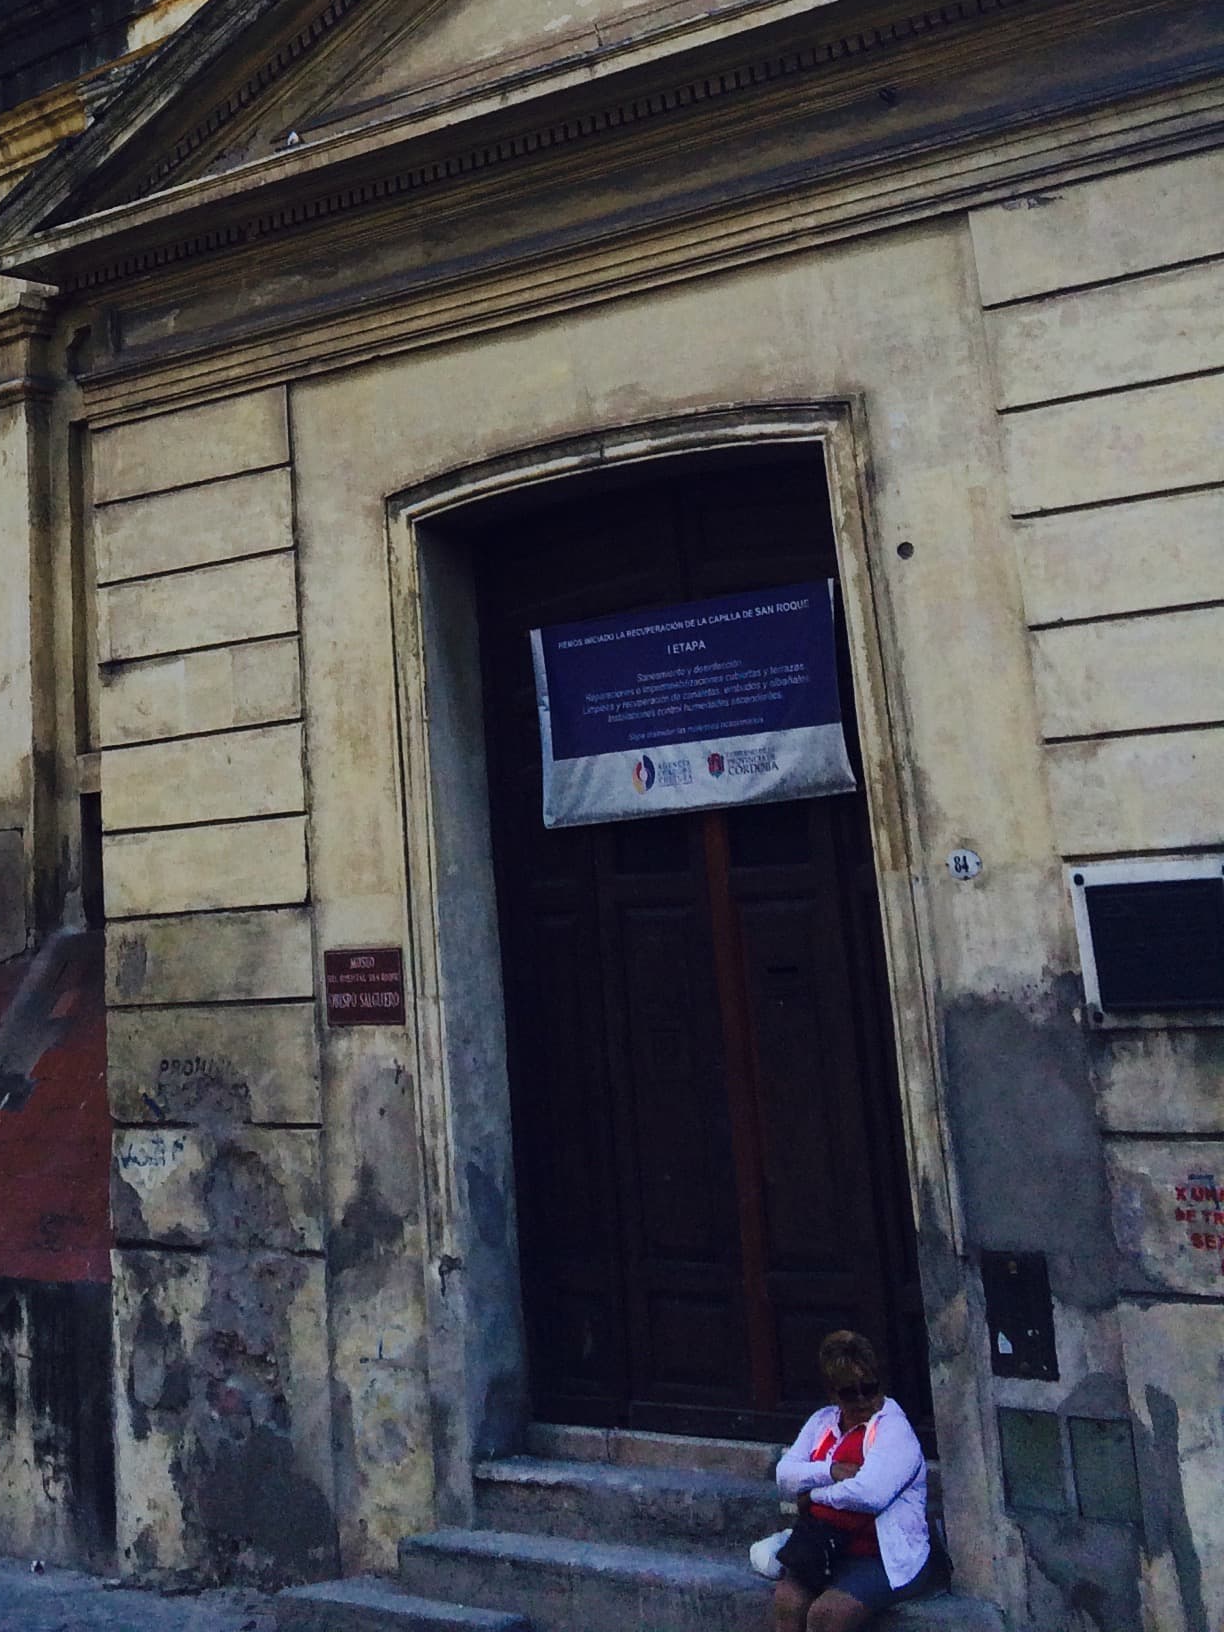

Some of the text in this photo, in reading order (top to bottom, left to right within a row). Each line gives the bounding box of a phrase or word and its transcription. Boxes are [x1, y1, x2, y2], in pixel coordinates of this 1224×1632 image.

[615, 631, 626, 640] LA
[684, 619, 695, 628] DE
[697, 617, 707, 626] LA
[708, 611, 741, 624] CAPILLA
[742, 609, 753, 618] DE
[755, 605, 774, 617] SAN
[776, 599, 809, 613] ROQUE
[673, 640, 706, 654] ETAPA
[953, 855, 970, 874] 84
